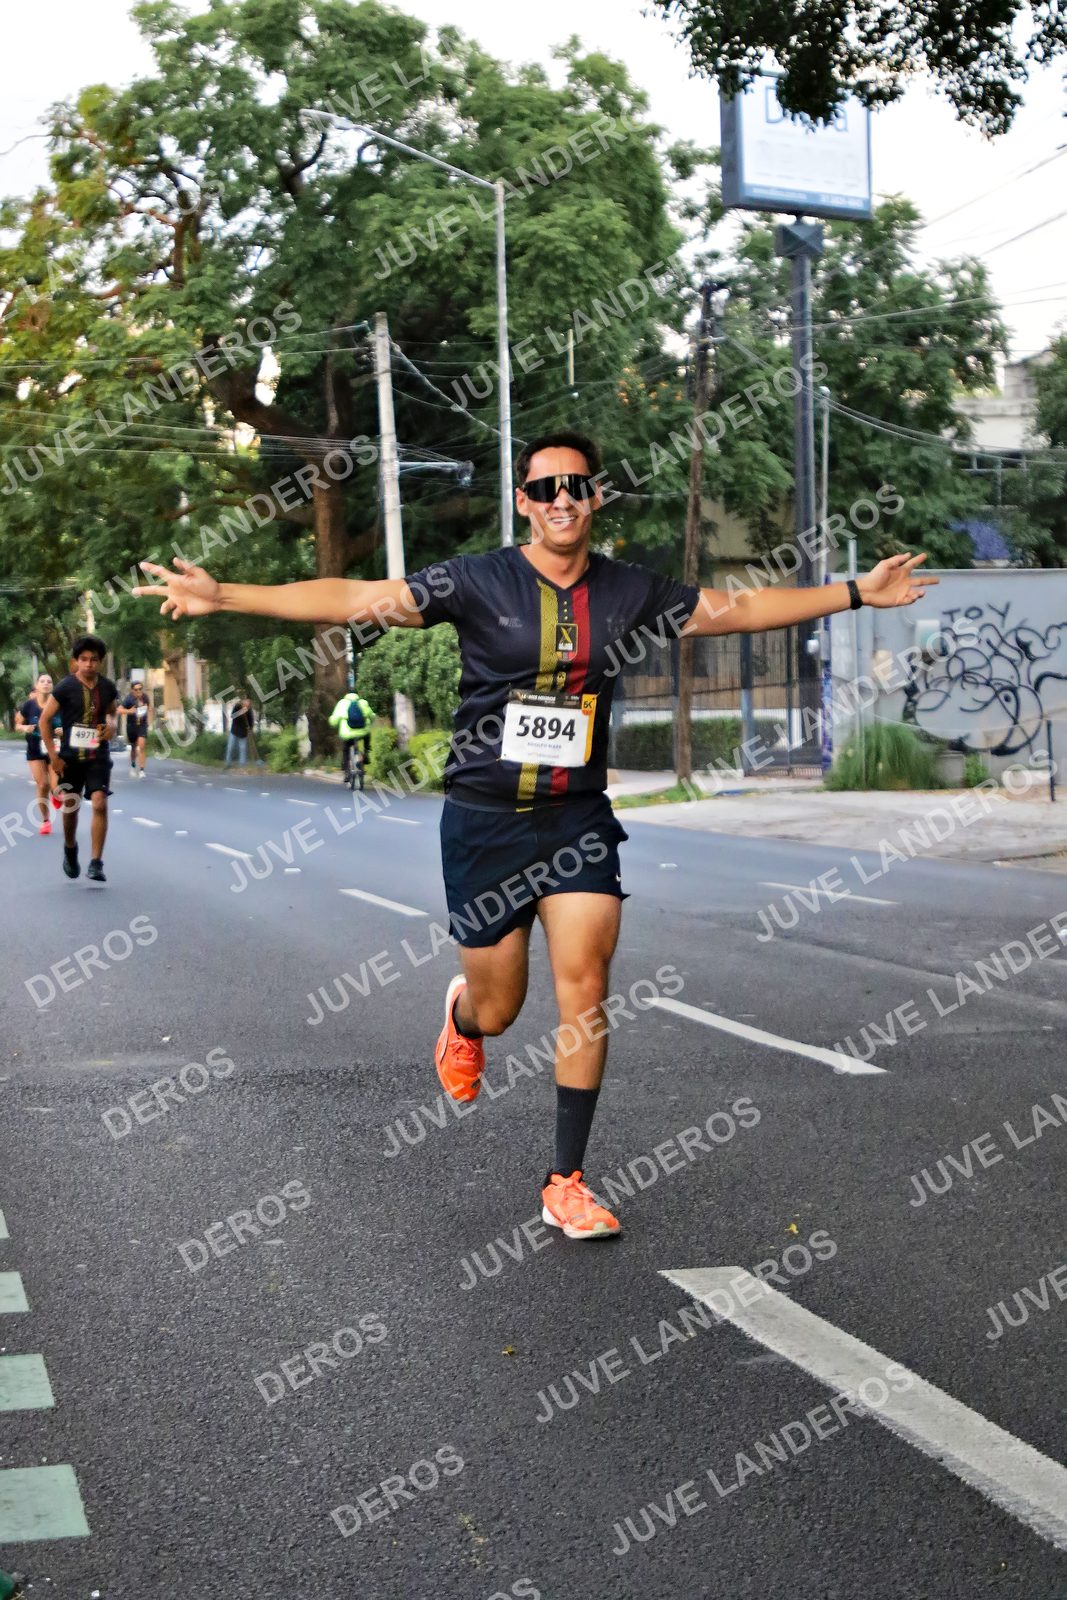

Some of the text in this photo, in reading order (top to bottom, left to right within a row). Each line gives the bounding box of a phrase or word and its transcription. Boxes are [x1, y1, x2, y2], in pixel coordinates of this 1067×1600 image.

[942, 601, 1010, 628] TOY
[75, 730, 96, 739] 4971
[516, 714, 576, 742] 5894
